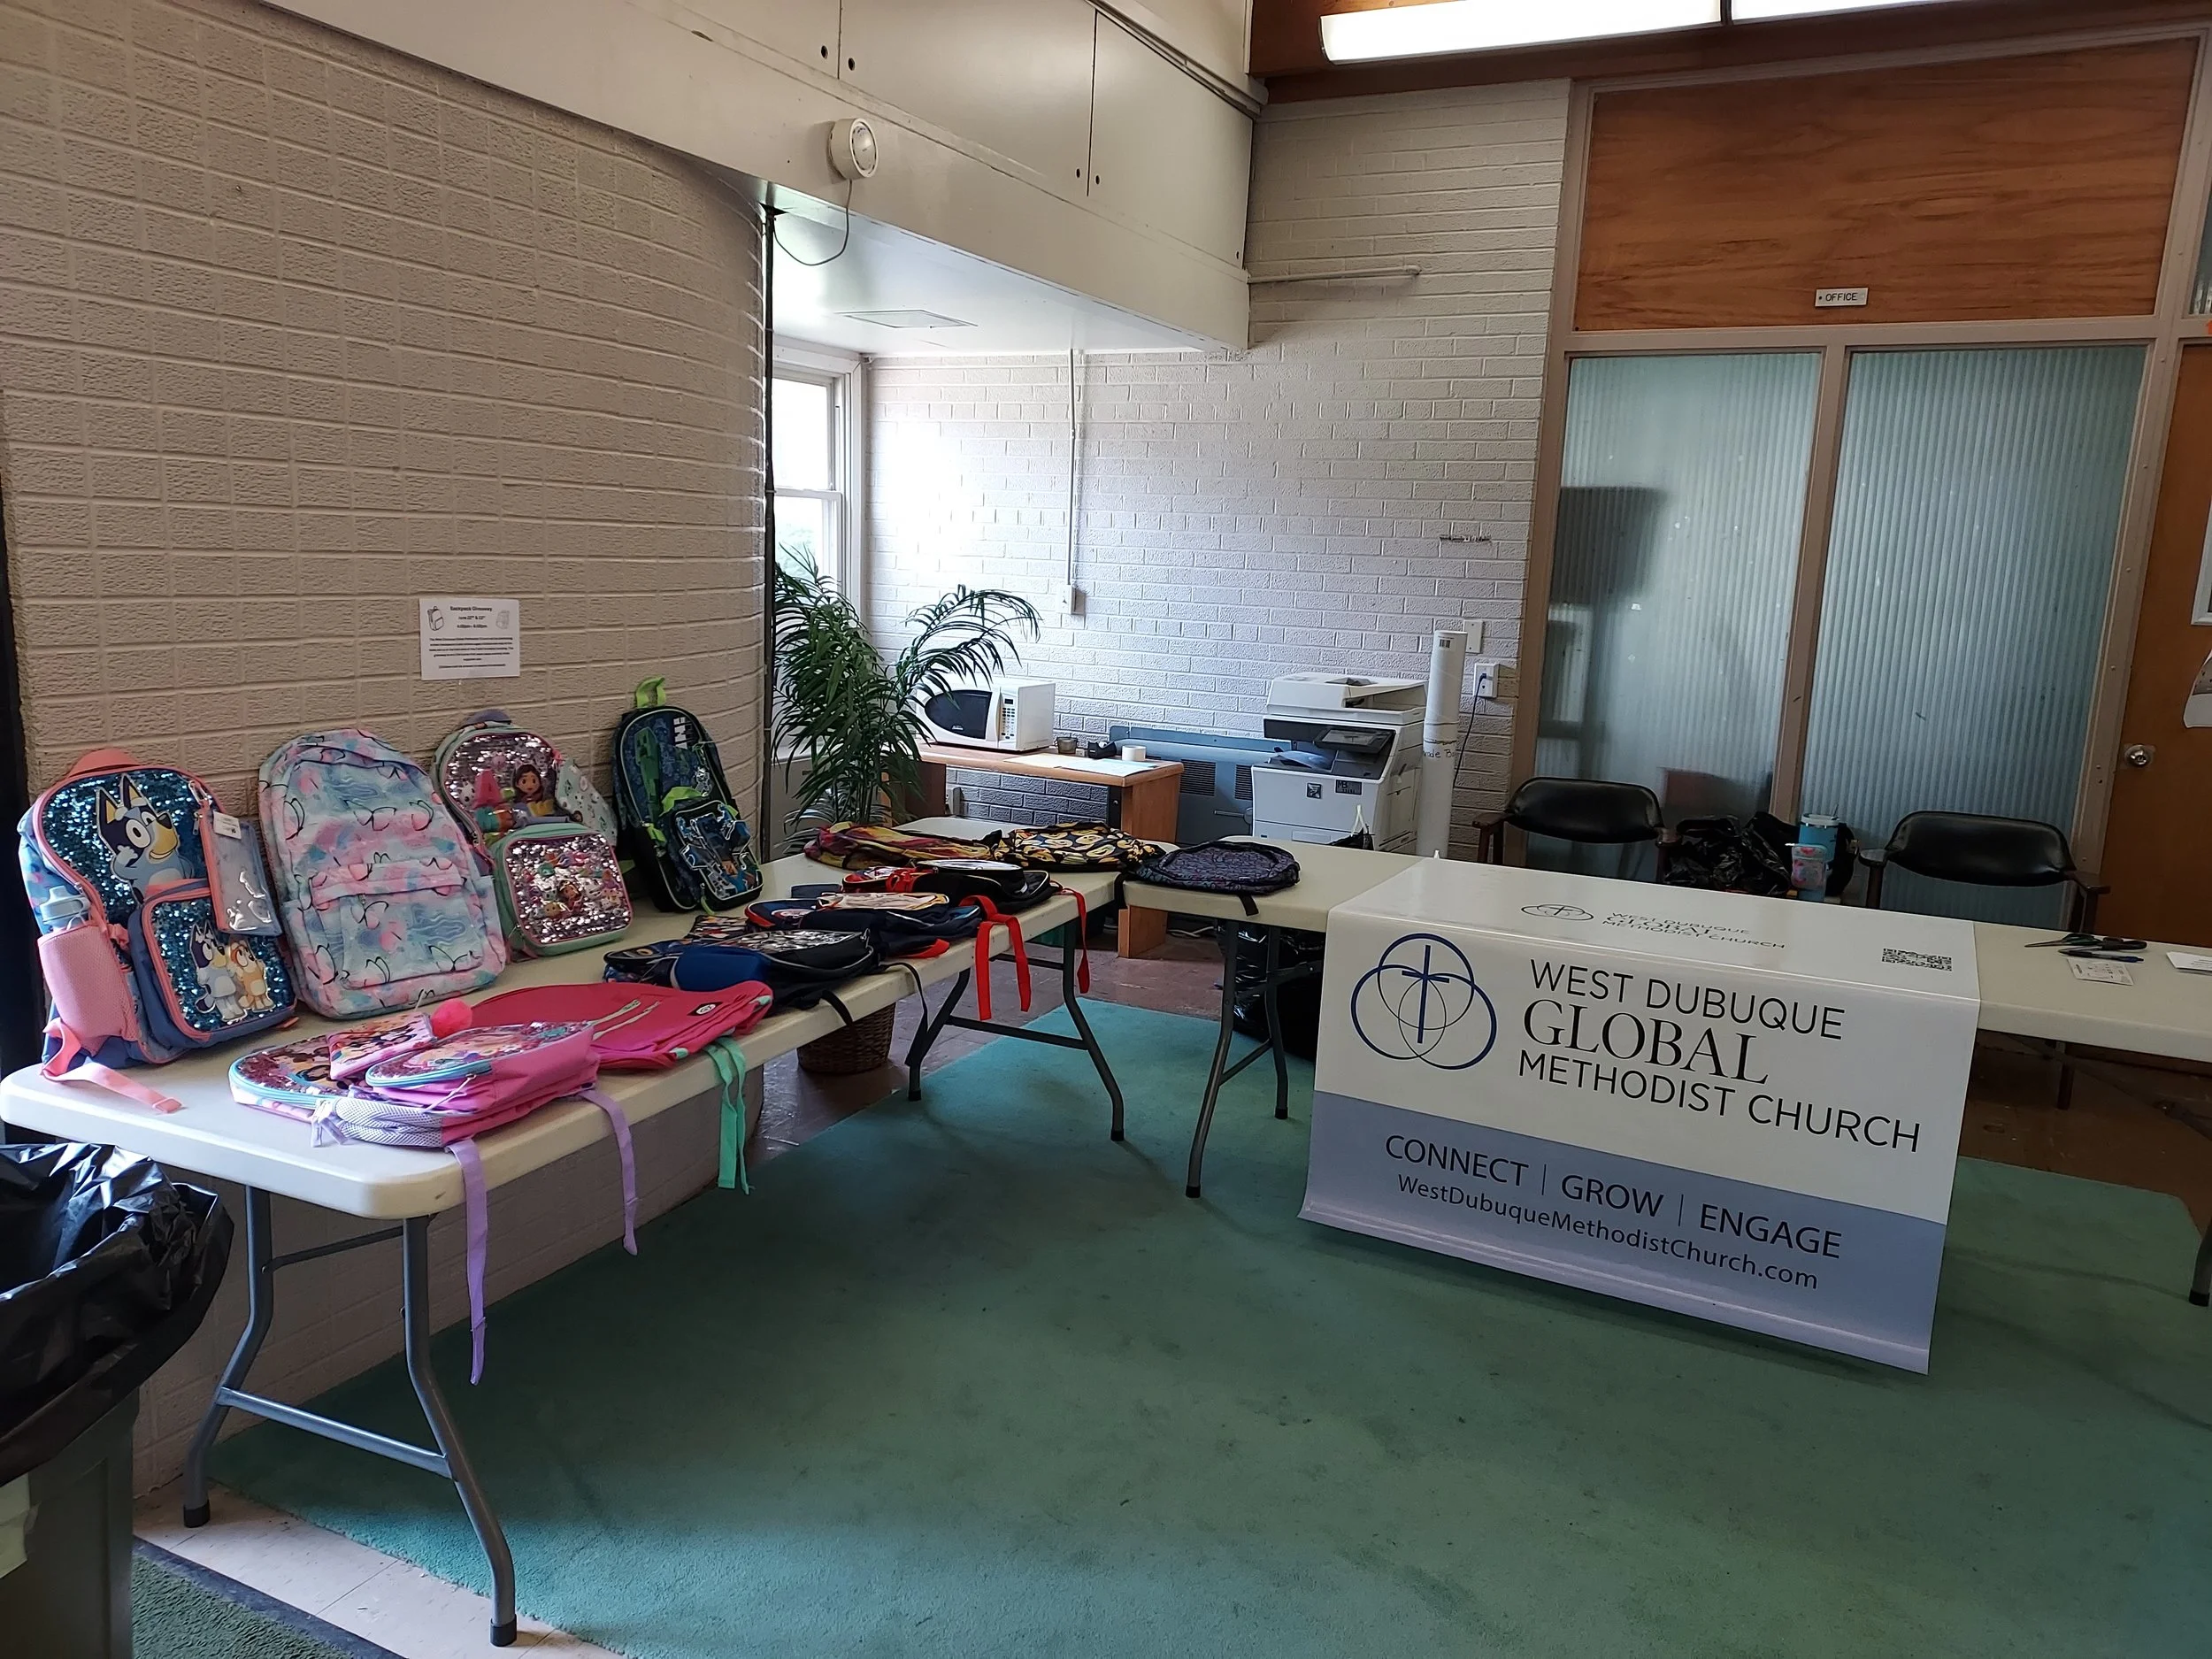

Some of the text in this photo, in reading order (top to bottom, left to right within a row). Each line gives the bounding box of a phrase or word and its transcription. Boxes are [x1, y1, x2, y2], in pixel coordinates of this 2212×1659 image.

[1825, 292, 1858, 302] OFFICE
[1601, 920, 1786, 949] METHODIST CHURCH
[1606, 916, 1710, 934] GLOBAL
[1612, 912, 1751, 934] WEST DUBUQUE
[1530, 958, 1846, 1041] WEST DUBUQUE
[1524, 999, 1769, 1085] GLOBAL
[1518, 1048, 1921, 1153] METHODIST CHURCH
[1386, 1134, 1843, 1259] CONNECT GROW ENGAGE
[1398, 1173, 1818, 1290] WestDubuqueMethodistChurch.com
